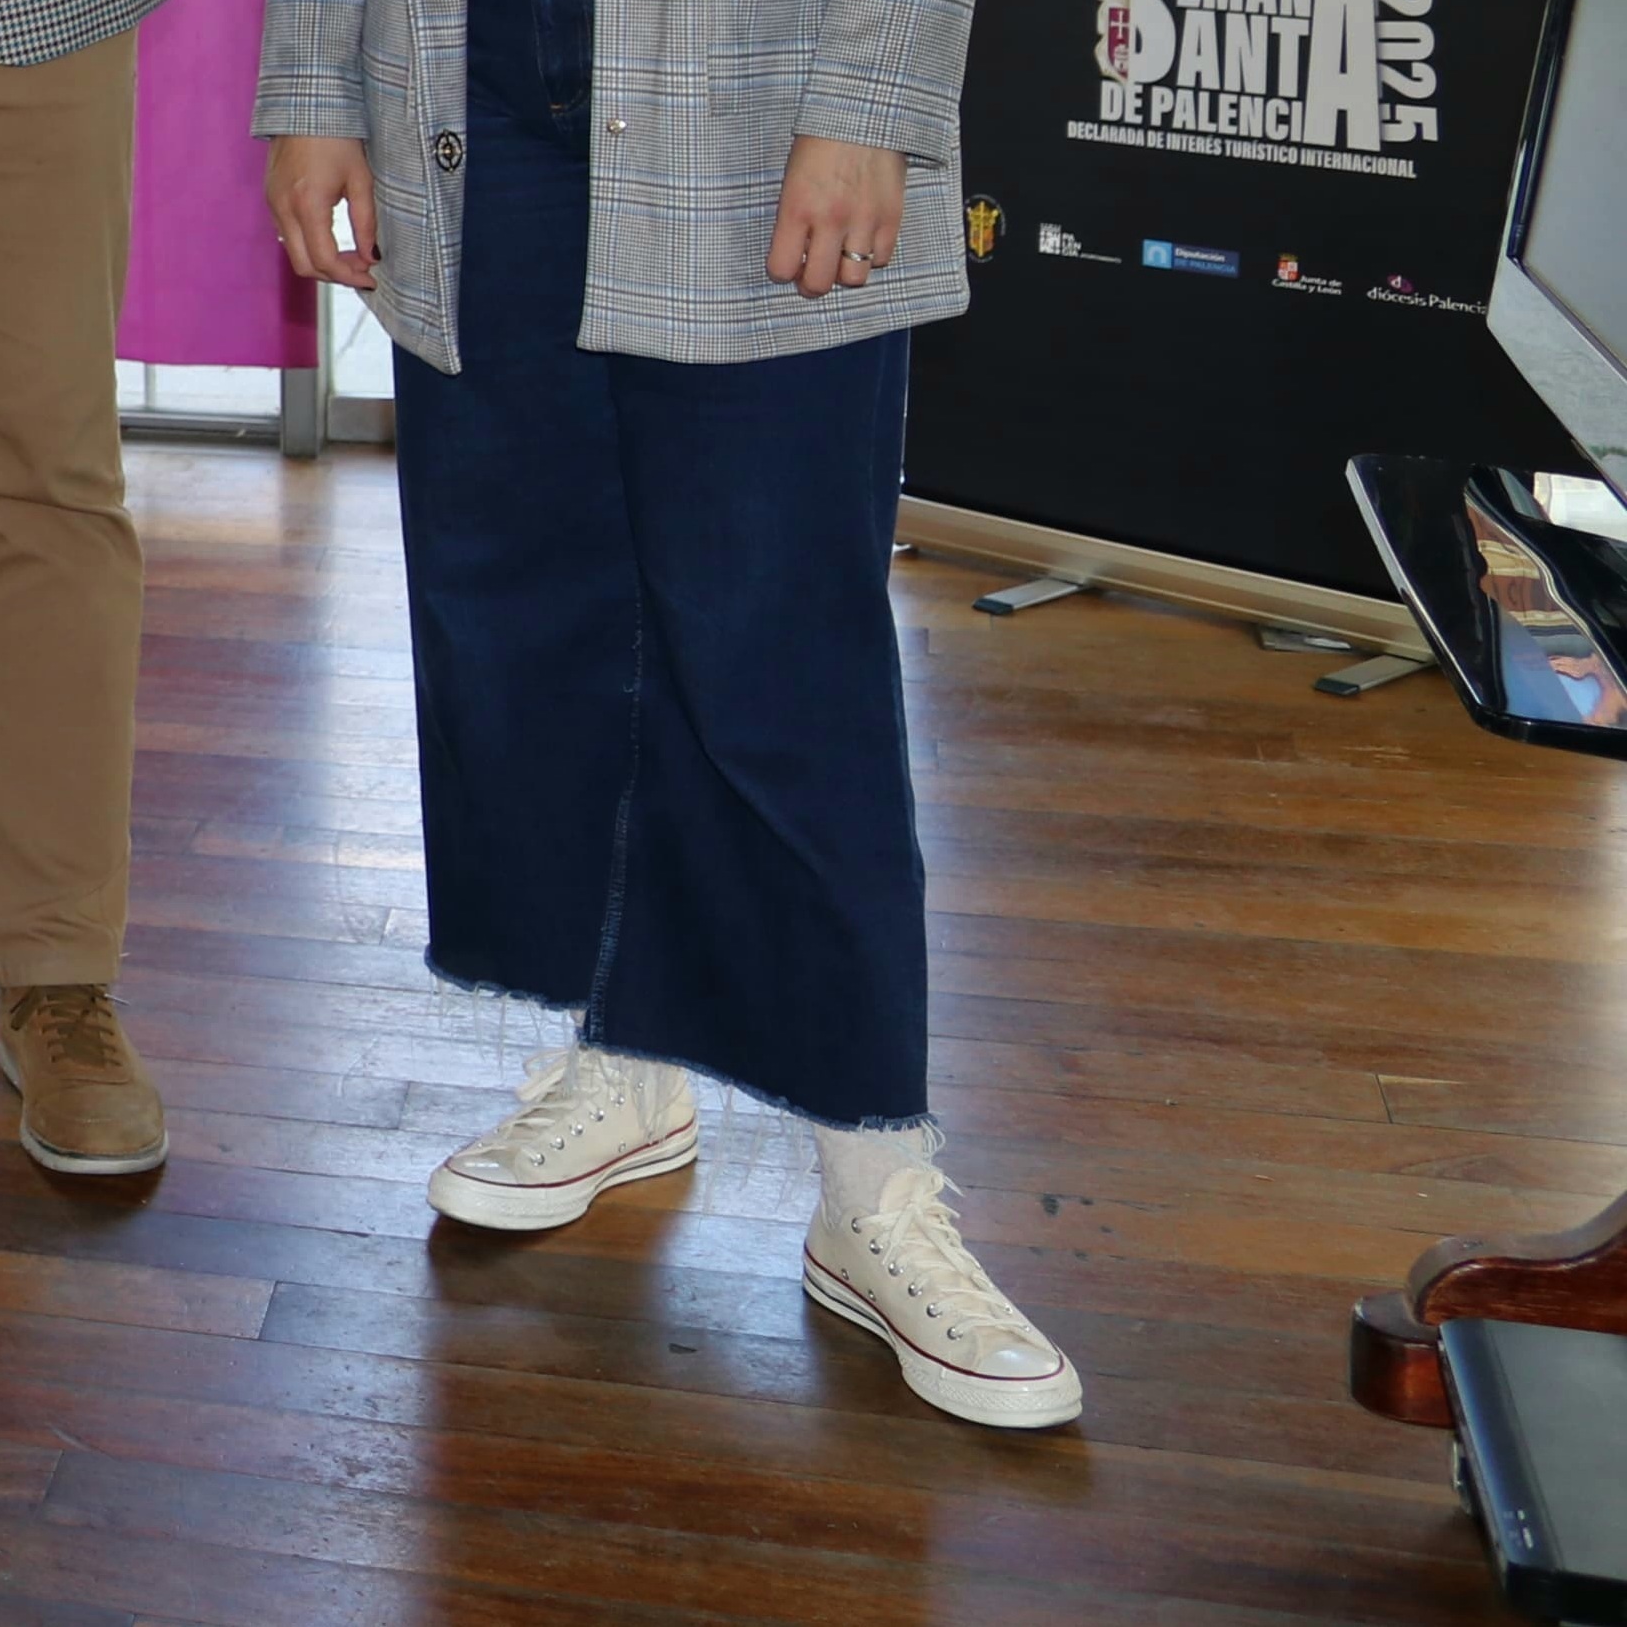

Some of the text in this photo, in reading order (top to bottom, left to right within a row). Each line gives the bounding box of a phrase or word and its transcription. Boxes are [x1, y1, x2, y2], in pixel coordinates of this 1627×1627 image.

[1100, 80, 1143, 124] DE
[1066, 120, 1417, 178] DECLARADA DE INTERÉS TURÍSTICO INTERNACIONAL
[1300, 275, 1343, 287] Junta de
[1366, 286, 1487, 314] diócesis Palencia
